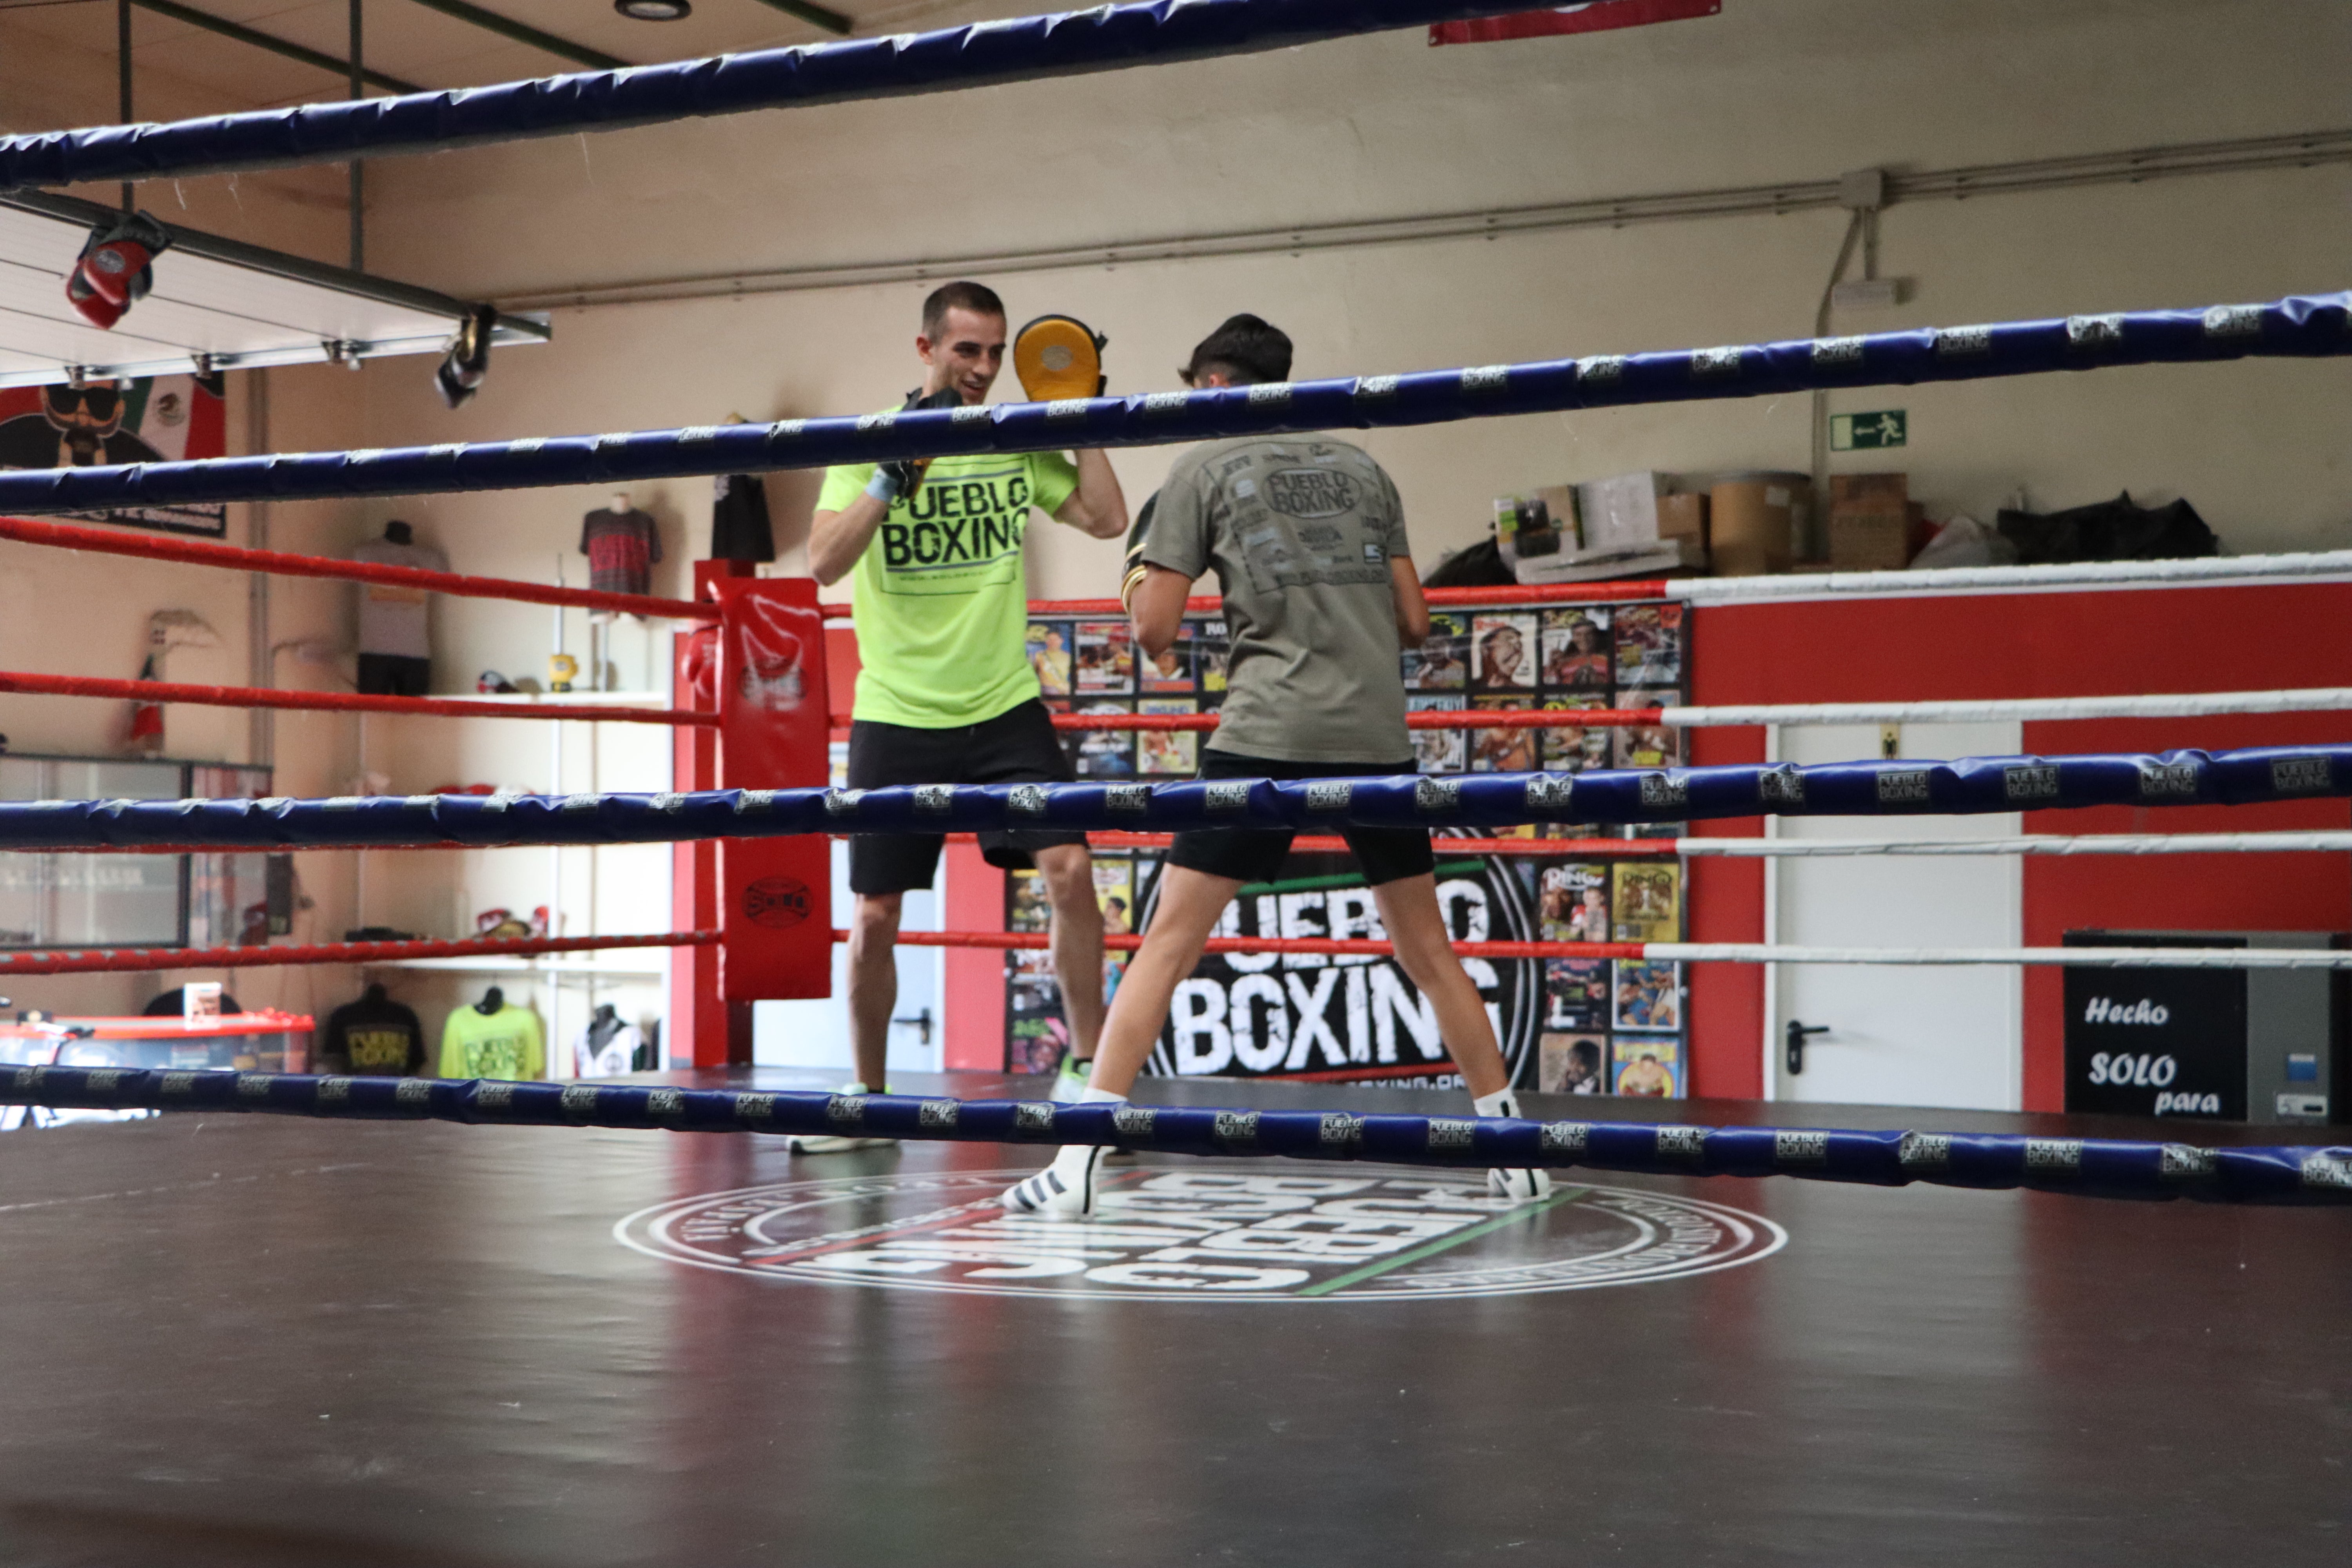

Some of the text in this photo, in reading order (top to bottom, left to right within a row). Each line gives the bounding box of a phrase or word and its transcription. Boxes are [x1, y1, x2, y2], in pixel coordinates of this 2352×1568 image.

[1938, 334, 1989, 353] BOXING
[1146, 396, 1185, 410] BOXING
[1249, 391, 1290, 404] BOXING
[1047, 404, 1086, 417] BOXING
[1266, 471, 1348, 492] PUEBLO
[1274, 488, 1355, 512] BOXING
[1207, 784, 1247, 794] PUEBLO
[1308, 783, 1350, 795] PUEBLO
[1206, 794, 1247, 807] BOXING
[1308, 794, 1350, 807] BOXING
[1642, 789, 1686, 804] BOXING
[2085, 997, 2169, 1025] Hecho
[2089, 1052, 2177, 1087] SOLO
[2154, 1091, 2221, 1116] para
[1216, 1123, 1254, 1136] BOXING
[1430, 1120, 1472, 1132] PUEBLO
[1429, 1131, 1471, 1144] BOXING
[1777, 1132, 1825, 1143] PUEBLO
[1777, 1142, 1824, 1156] BOXING
[2027, 1151, 2079, 1165] BOXING
